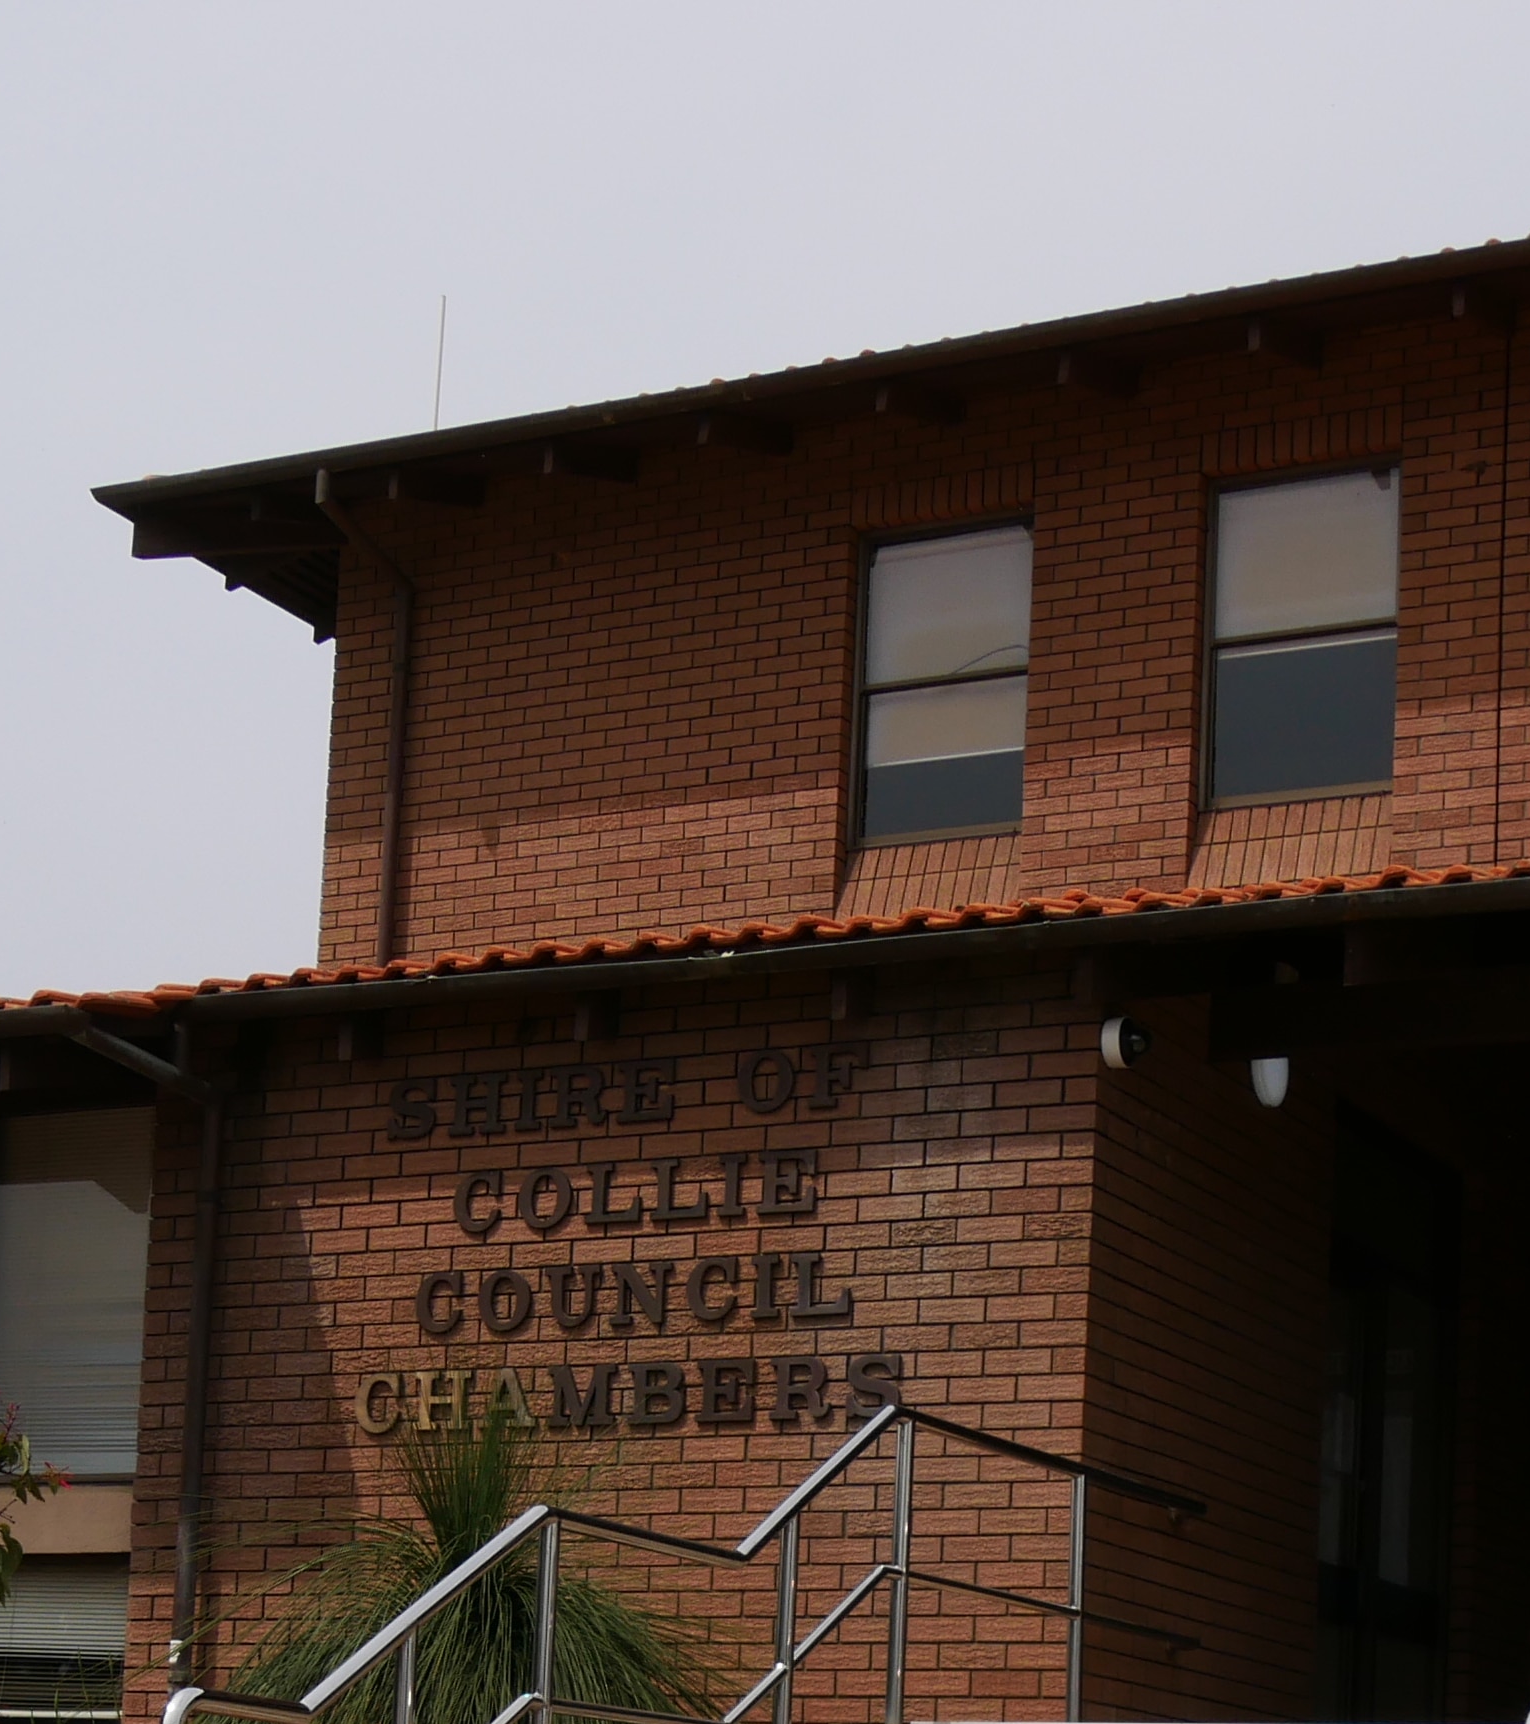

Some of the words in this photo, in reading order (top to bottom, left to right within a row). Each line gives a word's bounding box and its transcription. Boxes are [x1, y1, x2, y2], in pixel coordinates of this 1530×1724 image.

[388, 1058, 675, 1139] SHIRE
[738, 1046, 862, 1113] OF
[452, 1148, 820, 1234] COLLIE
[414, 1250, 854, 1333] COUNCIL
[355, 1353, 905, 1434] CHAMBERS
